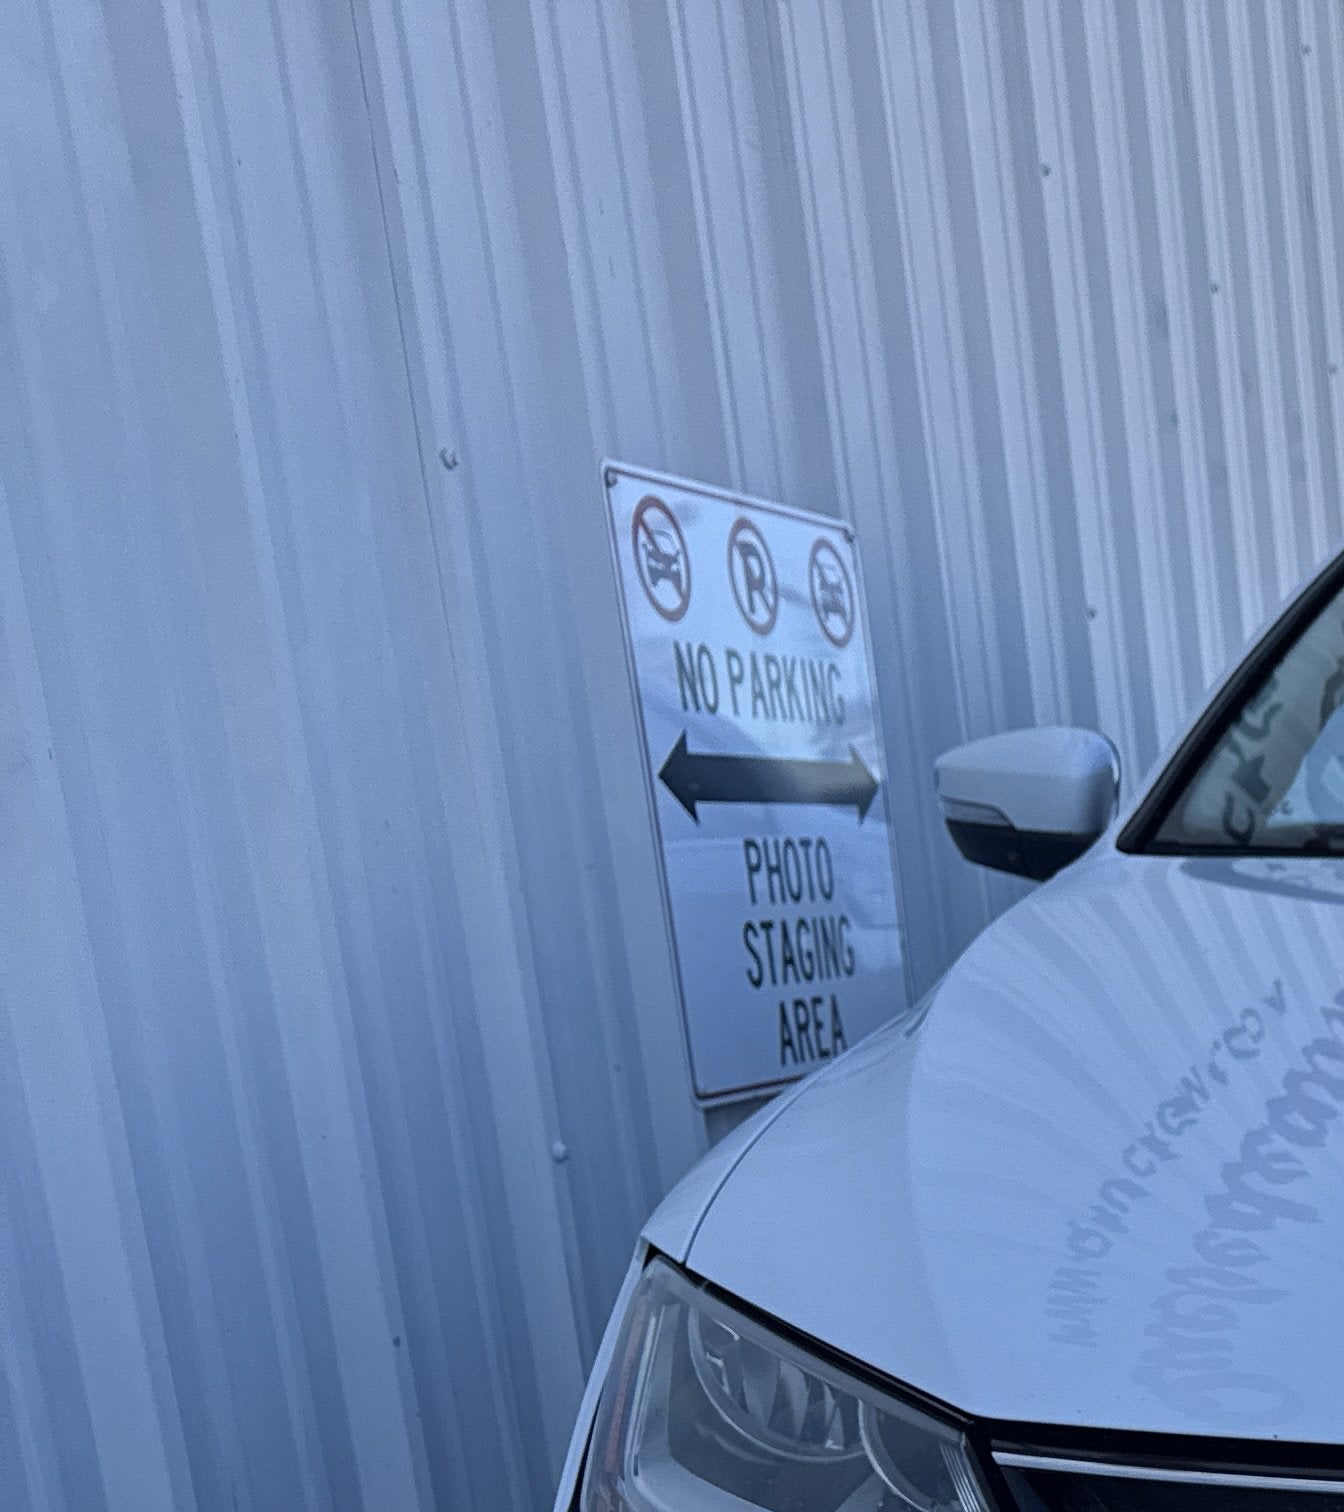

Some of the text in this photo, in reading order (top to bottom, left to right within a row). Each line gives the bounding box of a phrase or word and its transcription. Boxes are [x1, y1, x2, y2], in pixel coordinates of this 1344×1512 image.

[673, 639, 847, 726] NO PARKING
[743, 837, 834, 907] PHOTO
[742, 915, 856, 989] STAGING
[778, 993, 849, 1067] AREA
